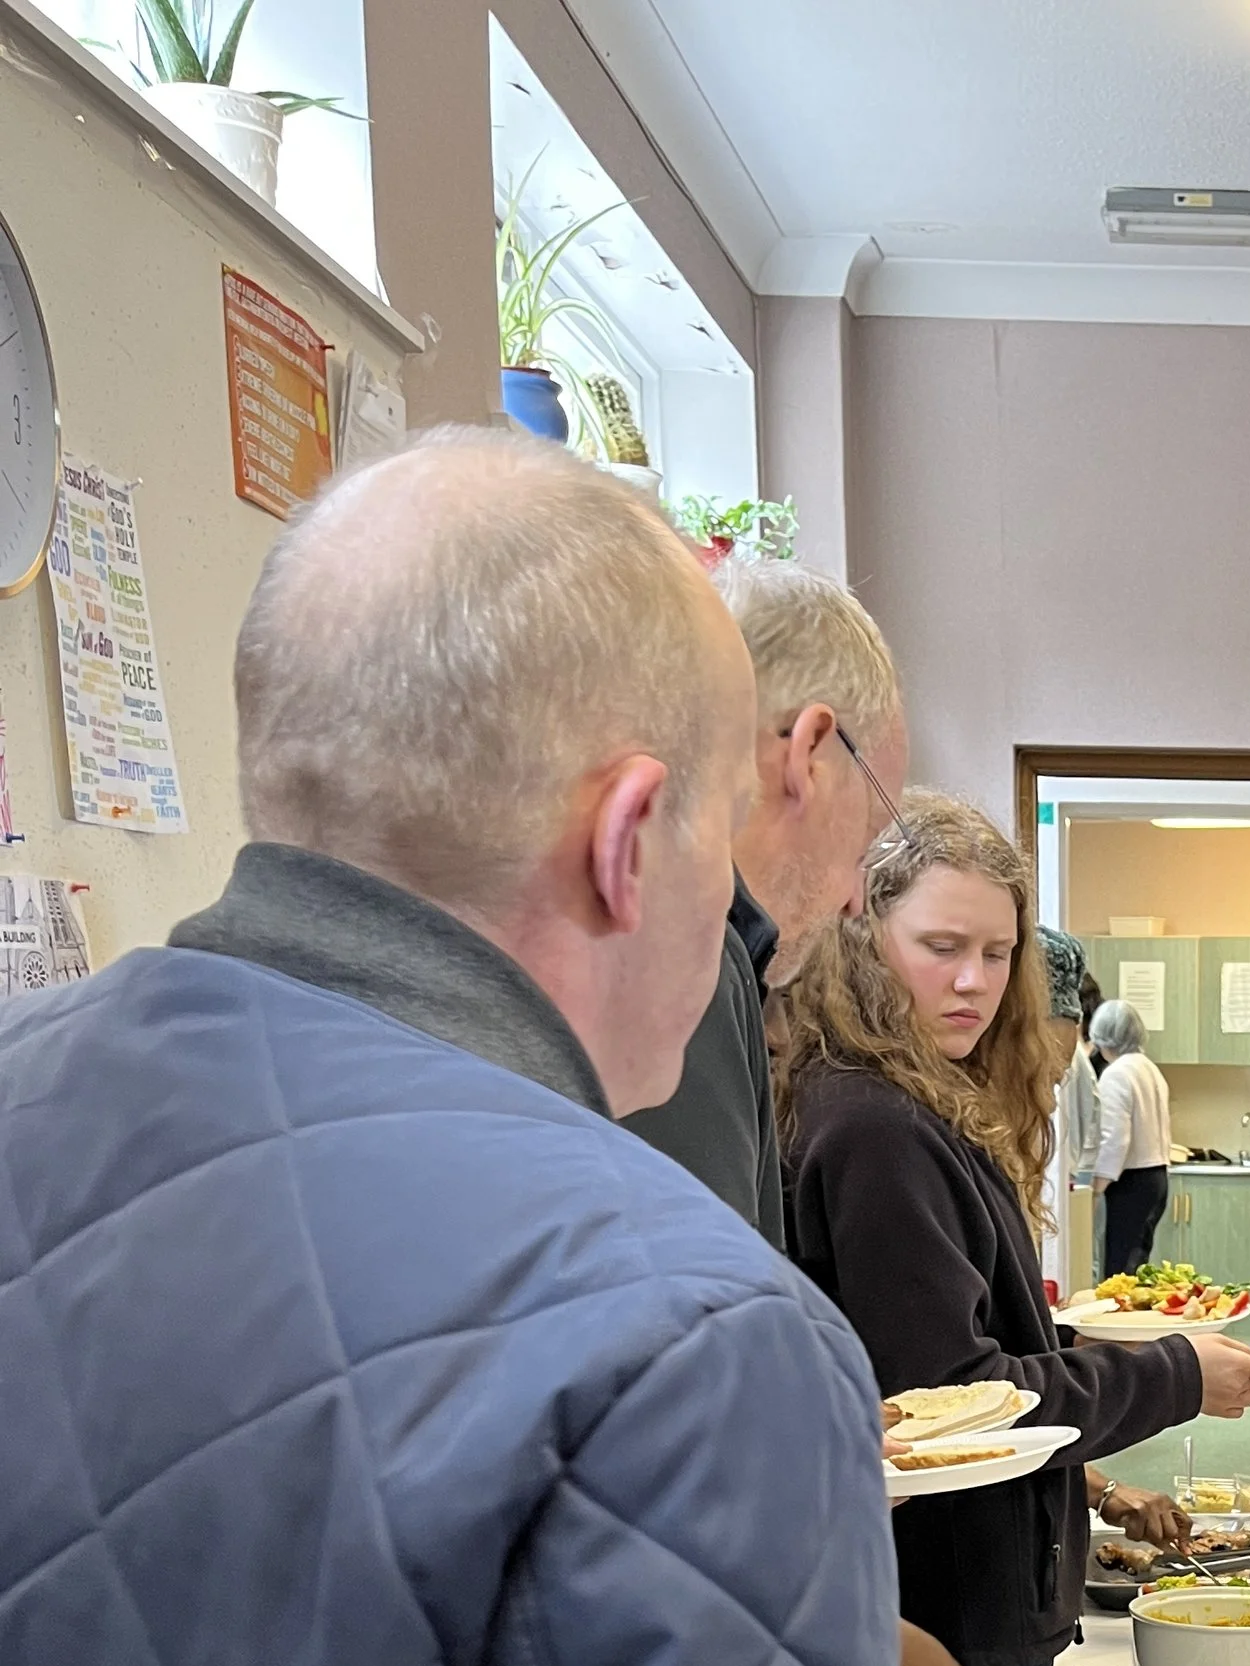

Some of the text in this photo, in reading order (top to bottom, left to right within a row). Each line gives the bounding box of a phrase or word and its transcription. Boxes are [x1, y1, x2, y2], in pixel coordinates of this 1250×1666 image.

[13, 394, 21, 445] 3
[121, 661, 157, 691] PEACE
[117, 758, 147, 783] TRUTH
[3, 930, 37, 944] BUILDING
